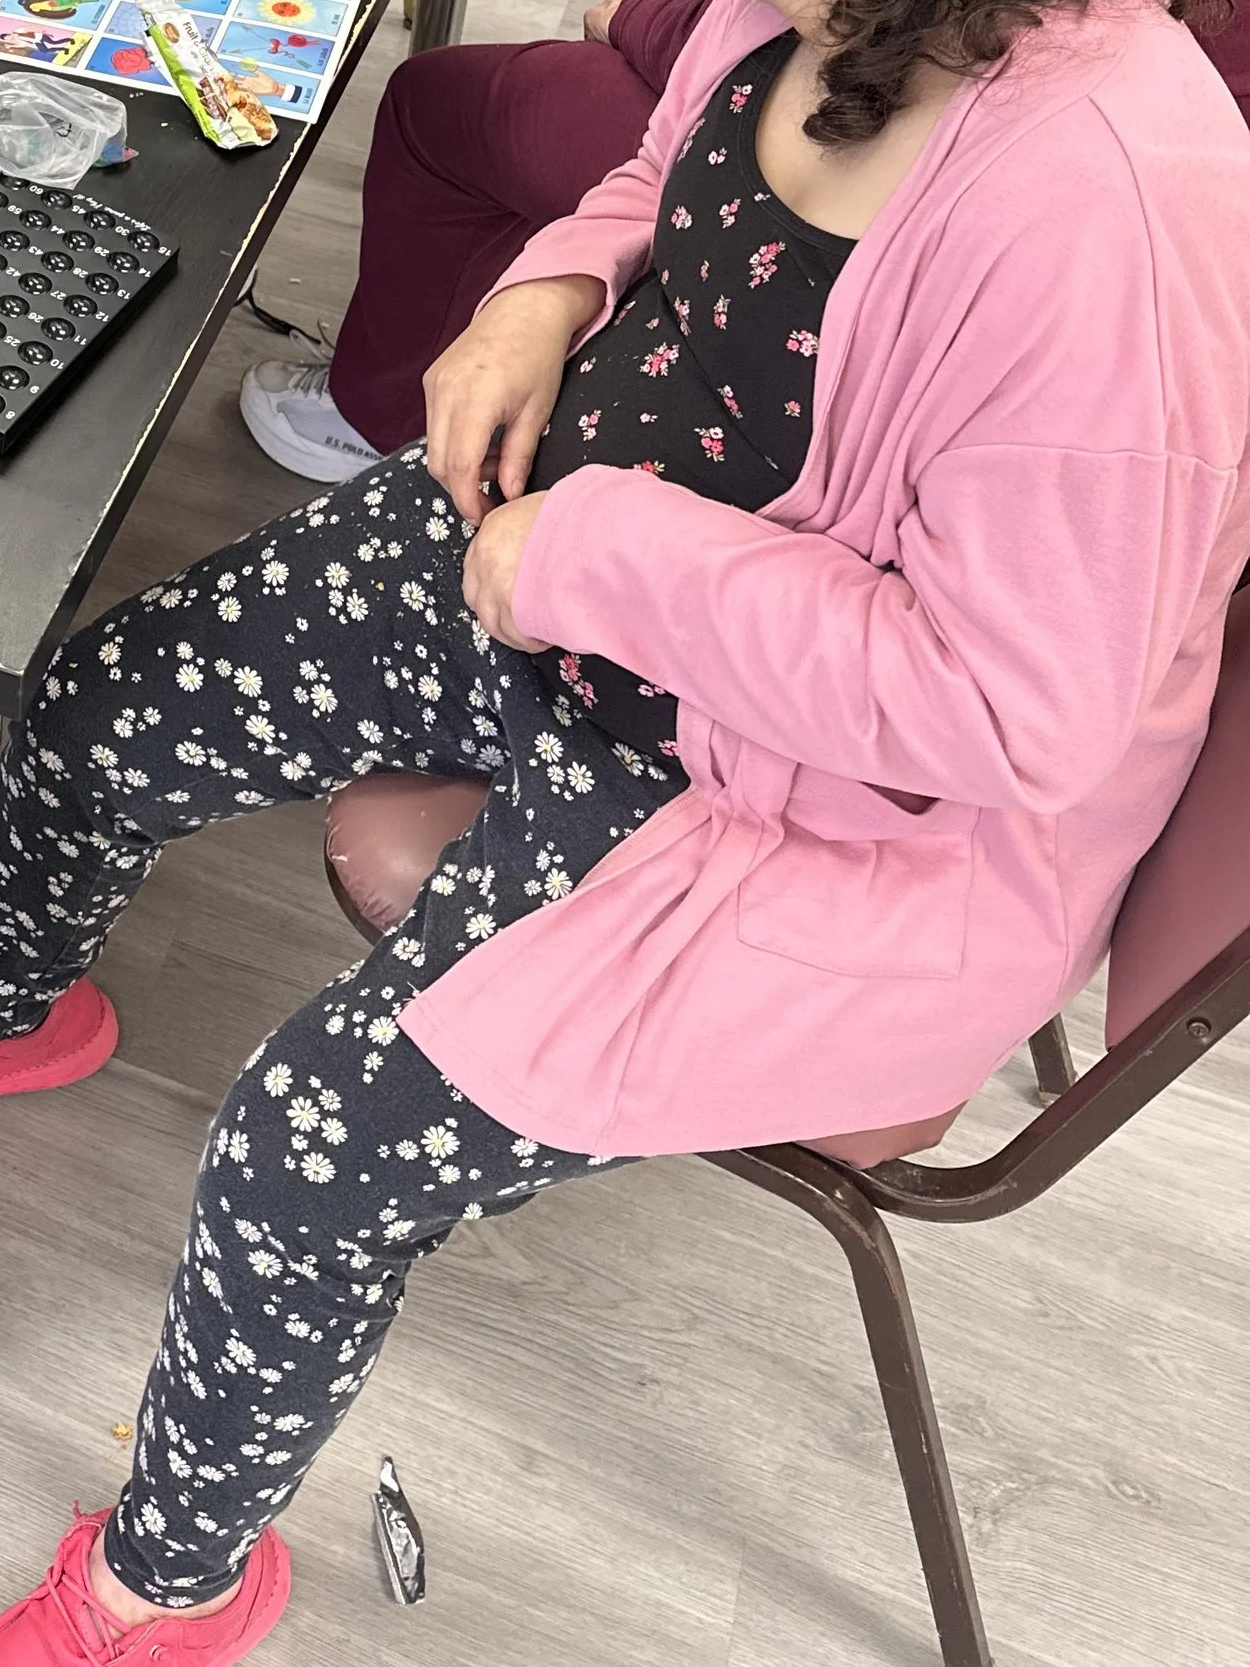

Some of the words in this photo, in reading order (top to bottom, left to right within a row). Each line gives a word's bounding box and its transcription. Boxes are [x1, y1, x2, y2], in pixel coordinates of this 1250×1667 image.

[183, 21, 199, 40] Fruit
[7, 205, 23, 214] 59
[29, 185, 44, 195] 60
[5, 267, 22, 277] 42
[28, 246, 44, 256] 43
[50, 225, 65, 235] 44
[71, 205, 86, 215] 45
[3, 335, 21, 346] 25
[27, 312, 44, 322] 26
[50, 290, 67, 300] 27
[72, 267, 89, 278] 28
[94, 246, 110, 256] 29
[115, 226, 130, 236] 30
[5, 410, 16, 420] 8
[29, 385, 40, 394] 9
[50, 358, 65, 369] 10
[74, 335, 86, 345] 11
[95, 311, 110, 322] 12
[116, 289, 132, 300] 13
[138, 267, 152, 278] 14
[158, 246, 172, 256] 15
[325, 436, 340, 448] U.S.
[342, 442, 363, 456] POLO
